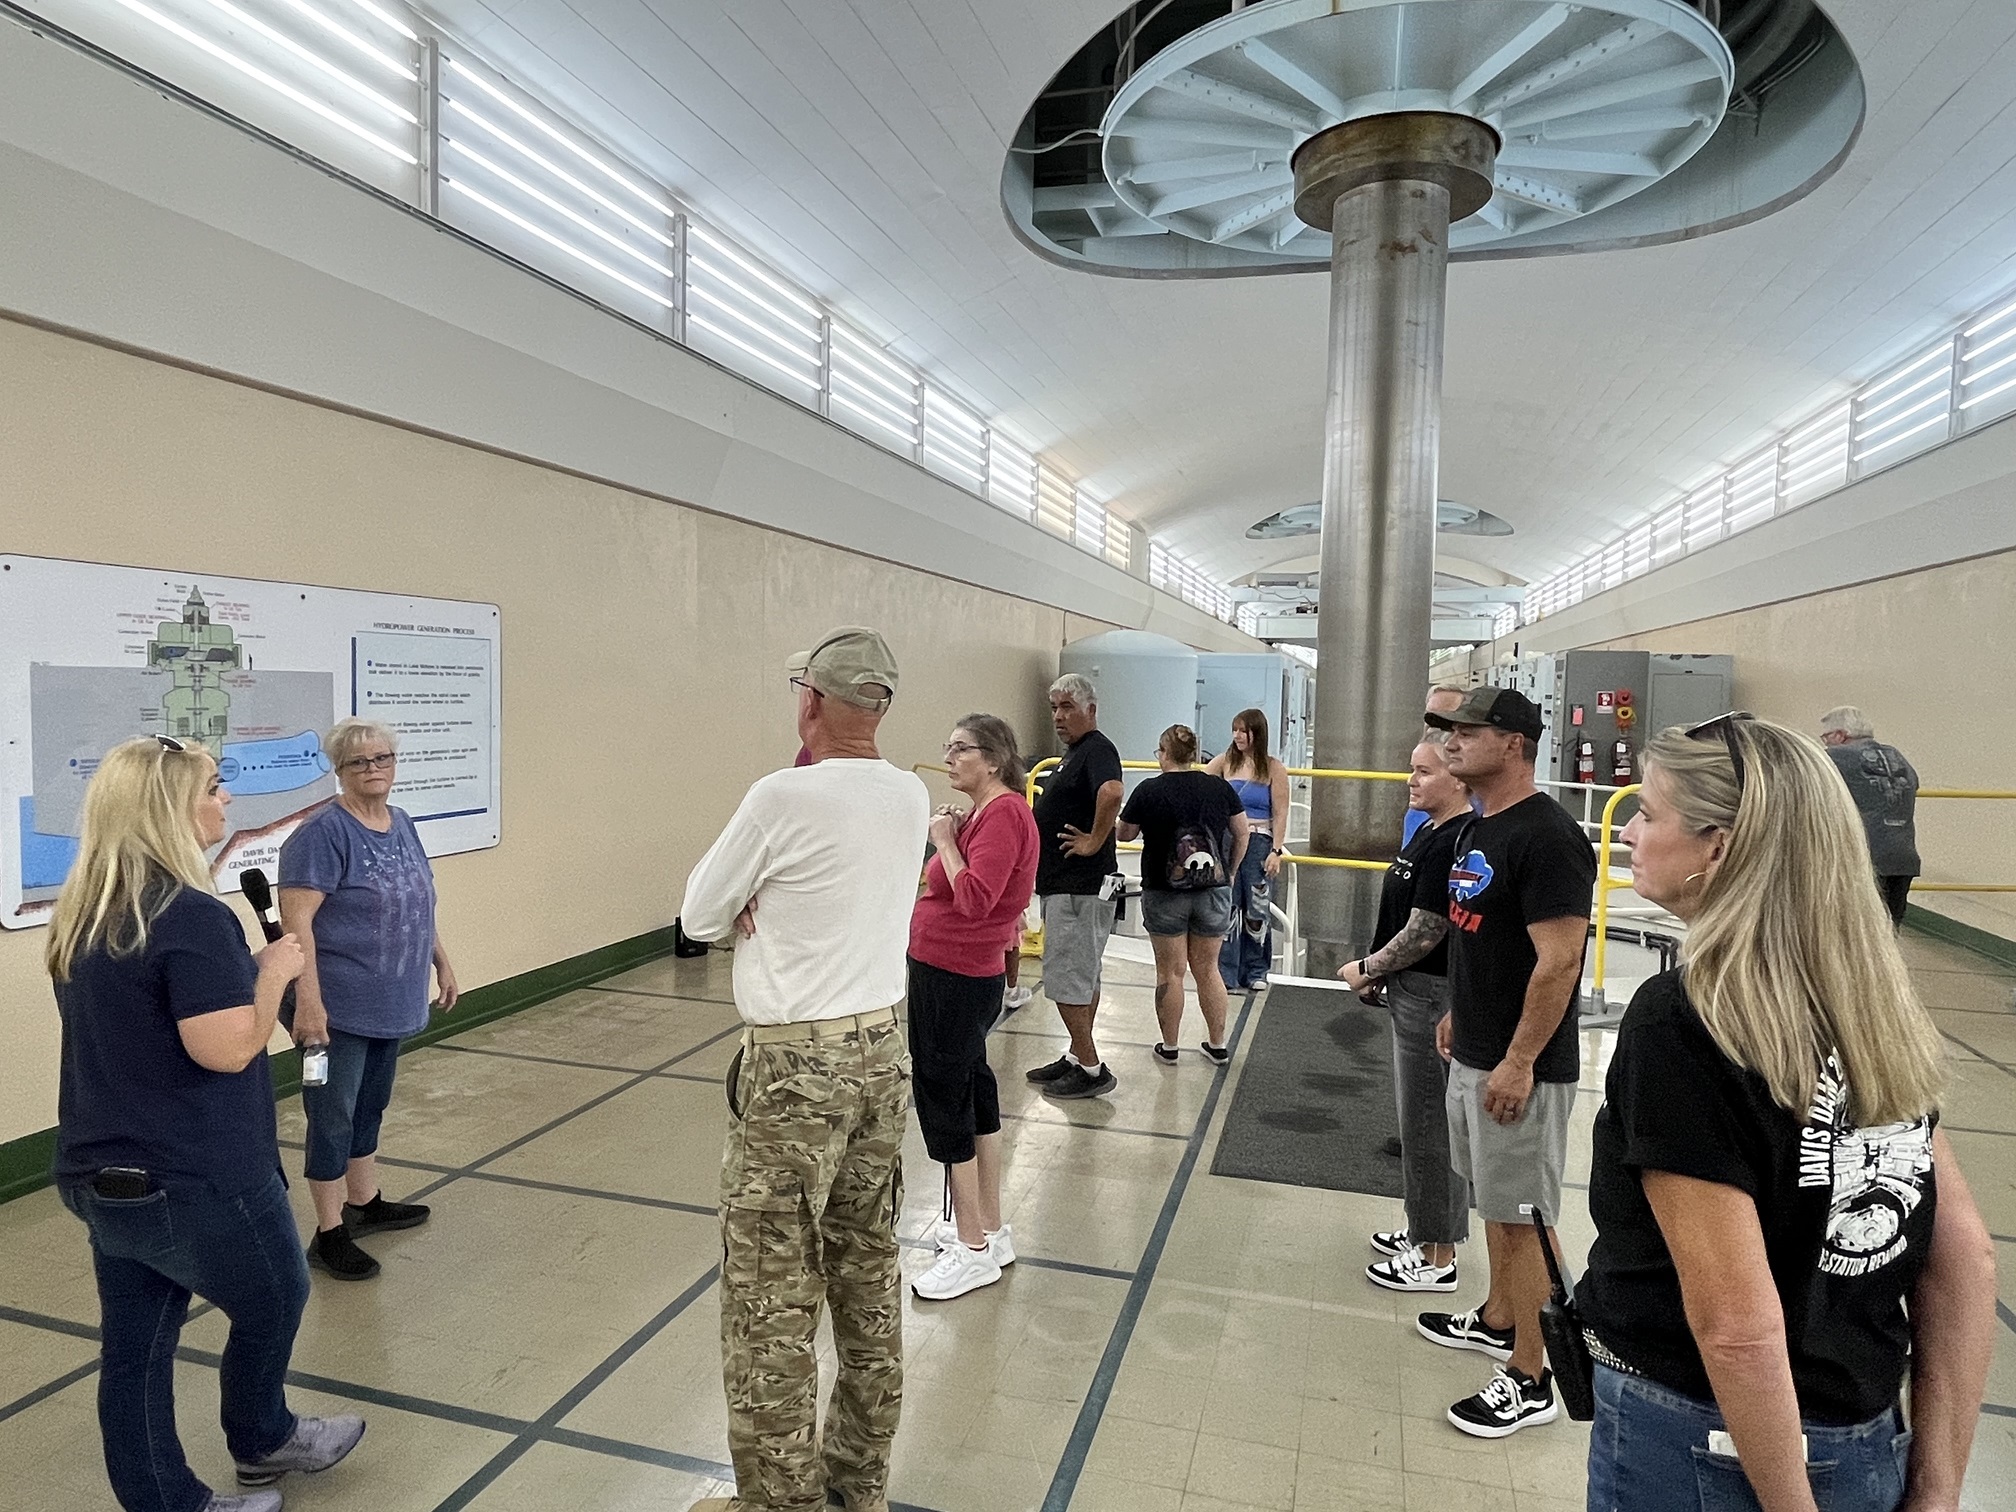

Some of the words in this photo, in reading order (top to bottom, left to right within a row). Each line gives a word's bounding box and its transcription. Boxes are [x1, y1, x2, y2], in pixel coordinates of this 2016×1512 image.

[373, 622, 414, 631] HYDROPOWER
[417, 624, 451, 634] GENERATION
[267, 846, 281, 855] DA
[228, 856, 276, 869] GENERATING
[1807, 1071, 1839, 1125] DAM
[1798, 1126, 1832, 1188] DAVIS
